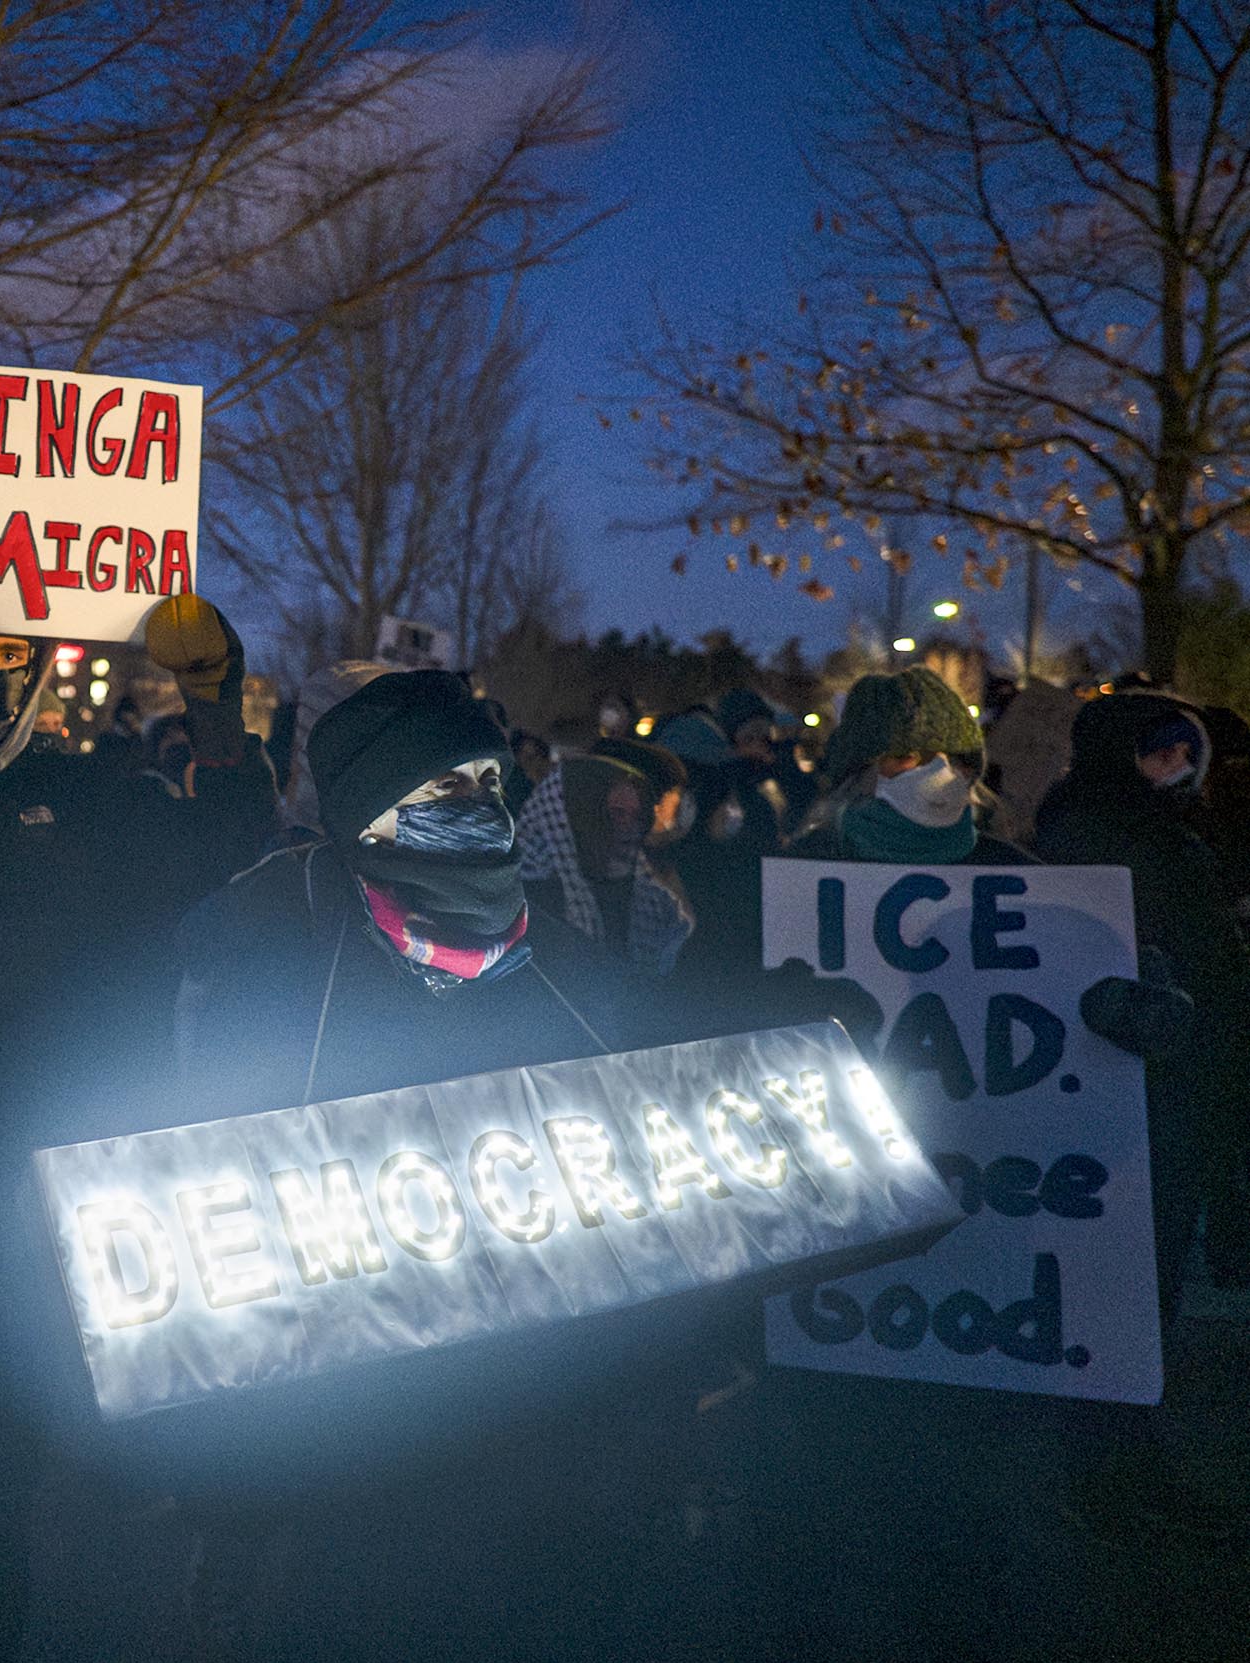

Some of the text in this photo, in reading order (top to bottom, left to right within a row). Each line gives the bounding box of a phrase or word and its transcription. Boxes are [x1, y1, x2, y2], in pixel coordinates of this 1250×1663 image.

[817, 872, 1041, 974] ICE
[880, 991, 1082, 1101] AD.
[74, 1067, 911, 1331] DEMOCRACY!
